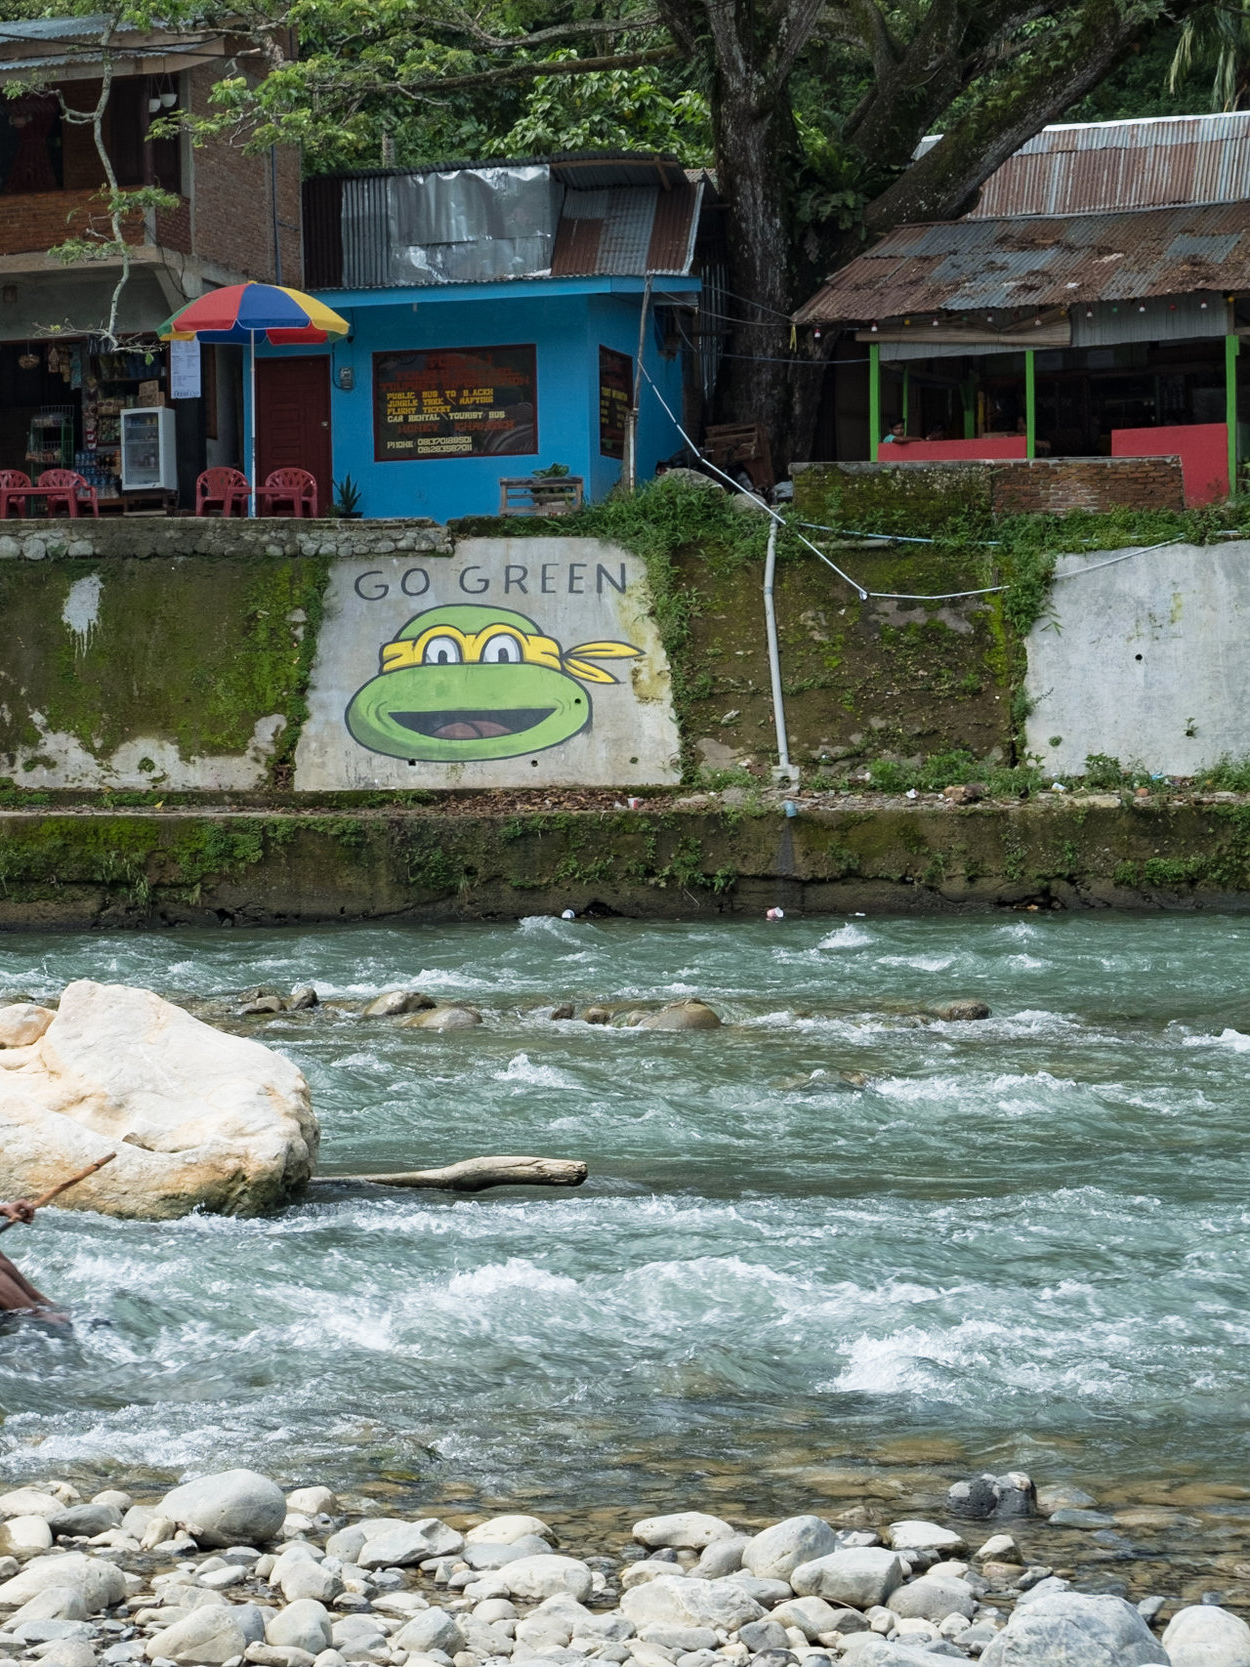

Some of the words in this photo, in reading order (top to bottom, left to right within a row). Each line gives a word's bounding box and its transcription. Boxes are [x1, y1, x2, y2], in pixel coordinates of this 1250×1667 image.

[386, 392, 415, 400] PUBLIC
[422, 390, 438, 399] BUS
[445, 390, 457, 398] TO
[387, 399, 418, 407] JUNGLE
[423, 397, 444, 406] TREK
[459, 396, 494, 405] RAFTING
[387, 407, 416, 415] FLIGHT
[423, 405, 451, 414] TICKET
[387, 414, 404, 423] CAR
[408, 413, 440, 422] RENTAL
[448, 411, 483, 420] TOURIST
[488, 410, 505, 419] BUS
[398, 423, 439, 434] MONEY
[354, 567, 431, 601] GO
[459, 562, 627, 595] GREEN
